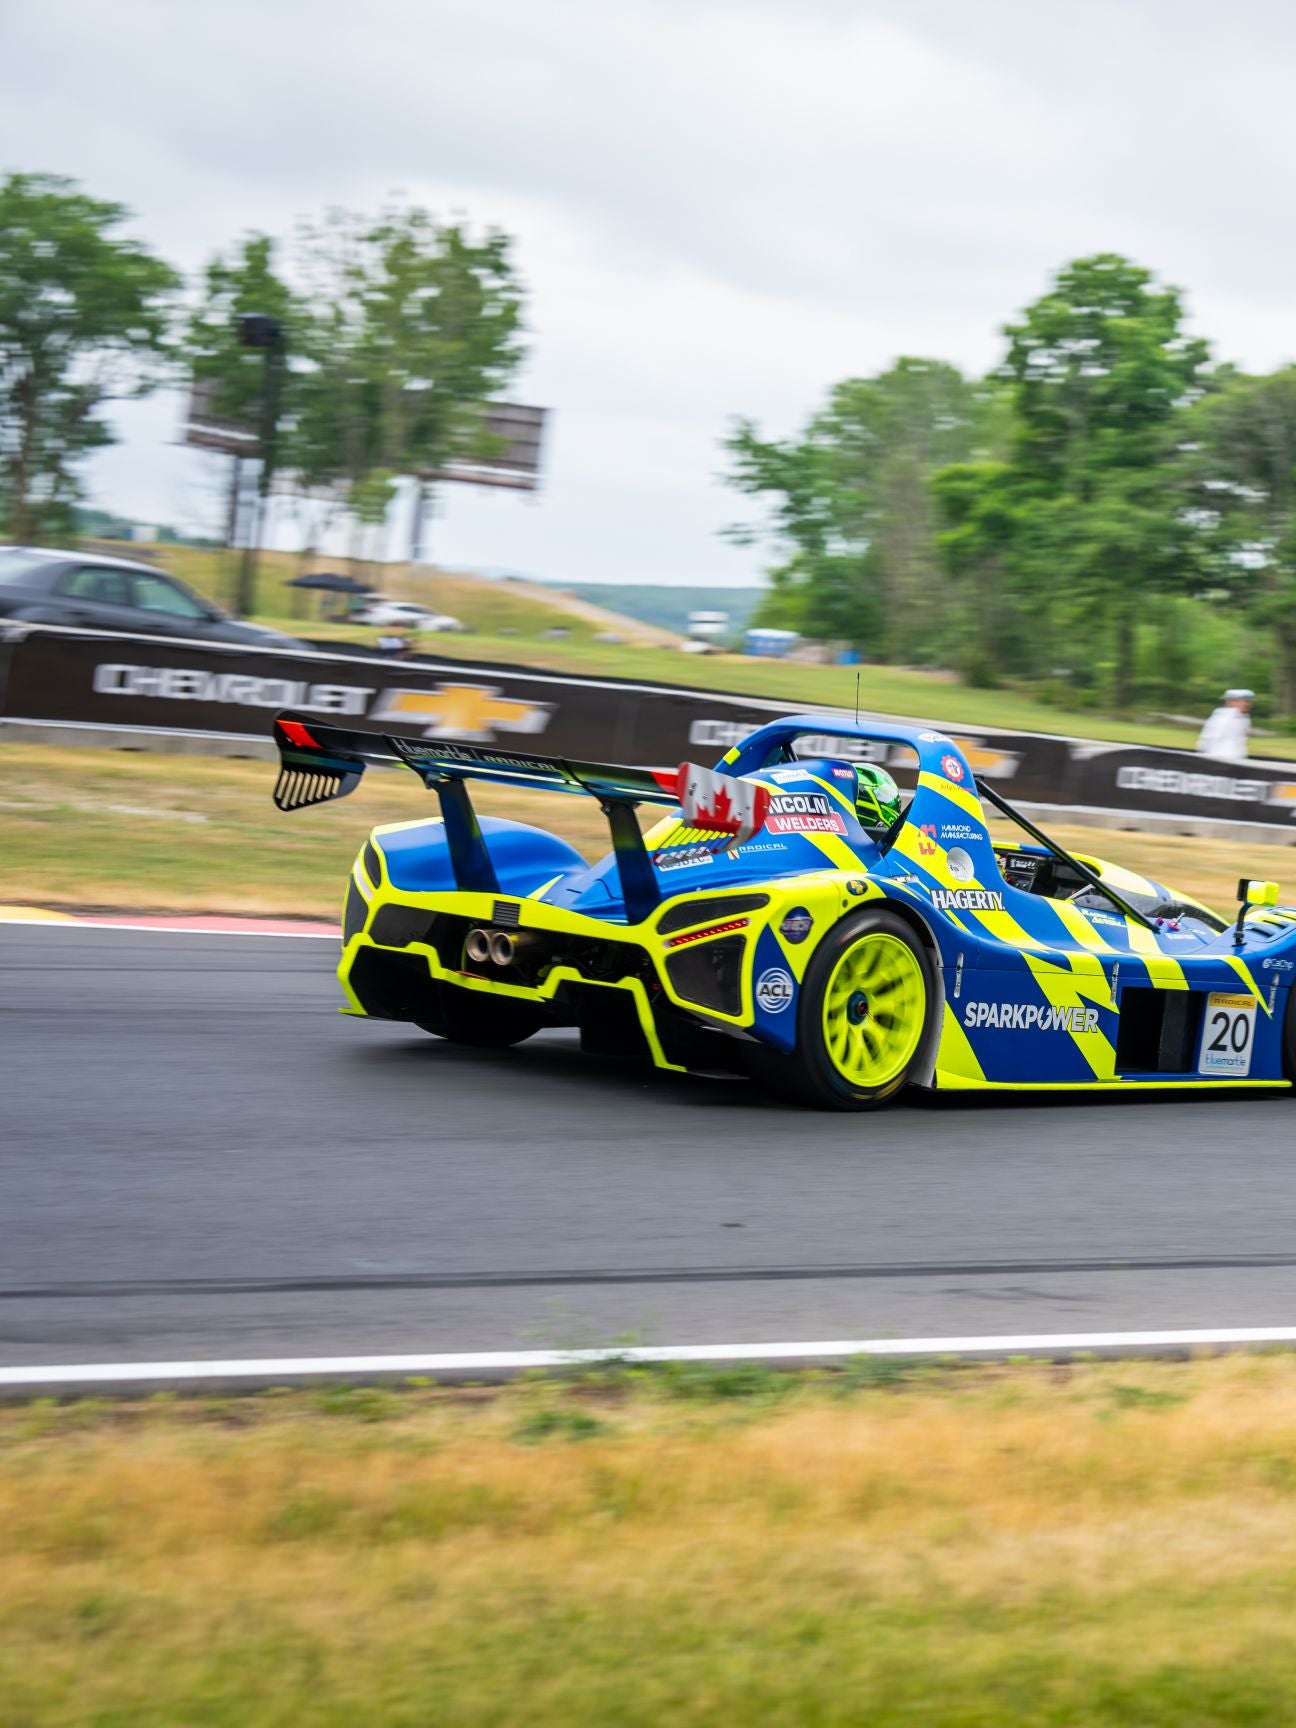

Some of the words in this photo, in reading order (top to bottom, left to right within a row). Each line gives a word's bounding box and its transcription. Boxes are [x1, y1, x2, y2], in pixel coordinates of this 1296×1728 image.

[93, 663, 376, 715] CHEVROLET
[689, 720, 890, 763] CHEOLET
[1116, 766, 1272, 802] CHEVROLET
[774, 817, 840, 832] WELDERS
[759, 984, 791, 997] ACL
[1214, 998, 1254, 1007] RADICAL
[963, 1001, 1099, 1033] SPARKPOWER
[1207, 1011, 1250, 1053] 20
